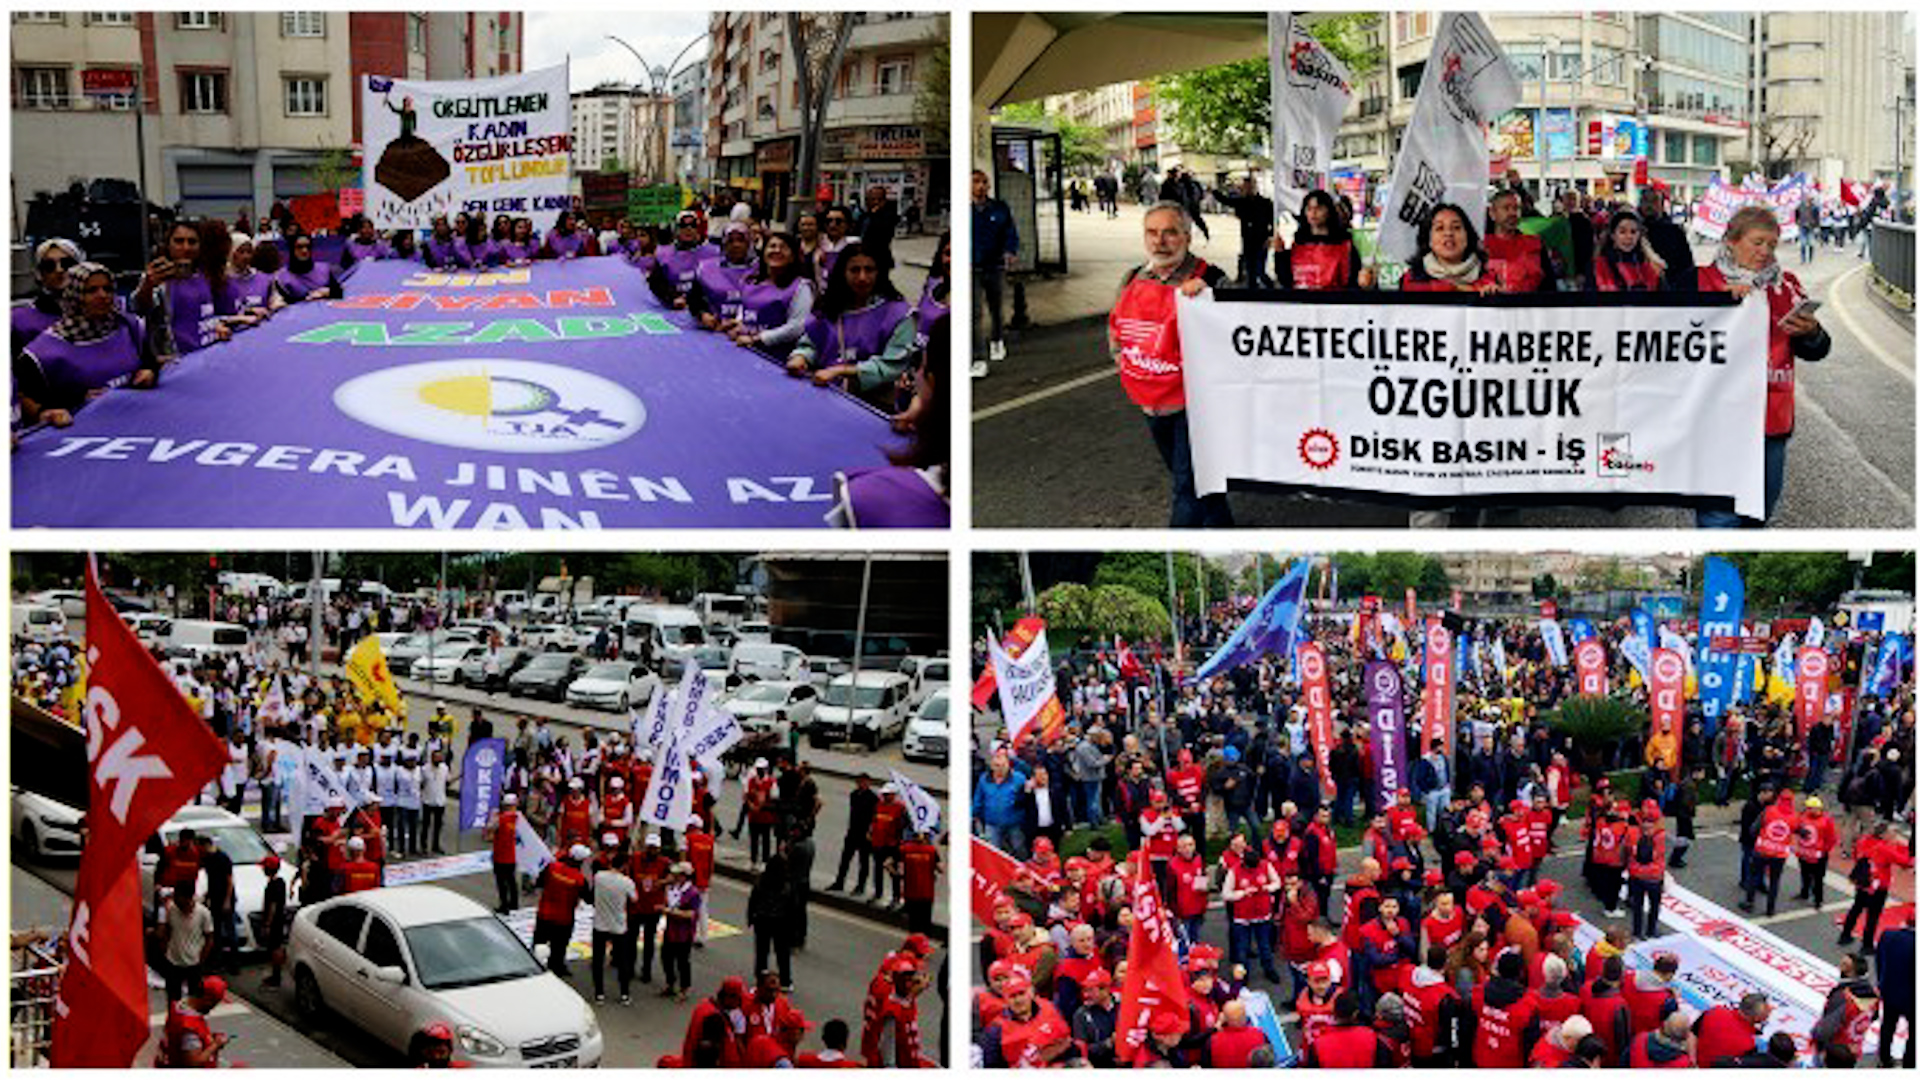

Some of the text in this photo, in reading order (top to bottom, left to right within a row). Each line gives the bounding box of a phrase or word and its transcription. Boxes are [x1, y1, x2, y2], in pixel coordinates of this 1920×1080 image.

[1232, 319, 1728, 369] GAZETECİLERE, HABERE, EMEĞE
[1367, 366, 1583, 418] ÖZGÜRLÜK
[45, 436, 419, 482] TEVGERA
[1350, 431, 1422, 463] DİSK
[1432, 440, 1528, 464] BASIN
[1556, 432, 1587, 468] İŞ
